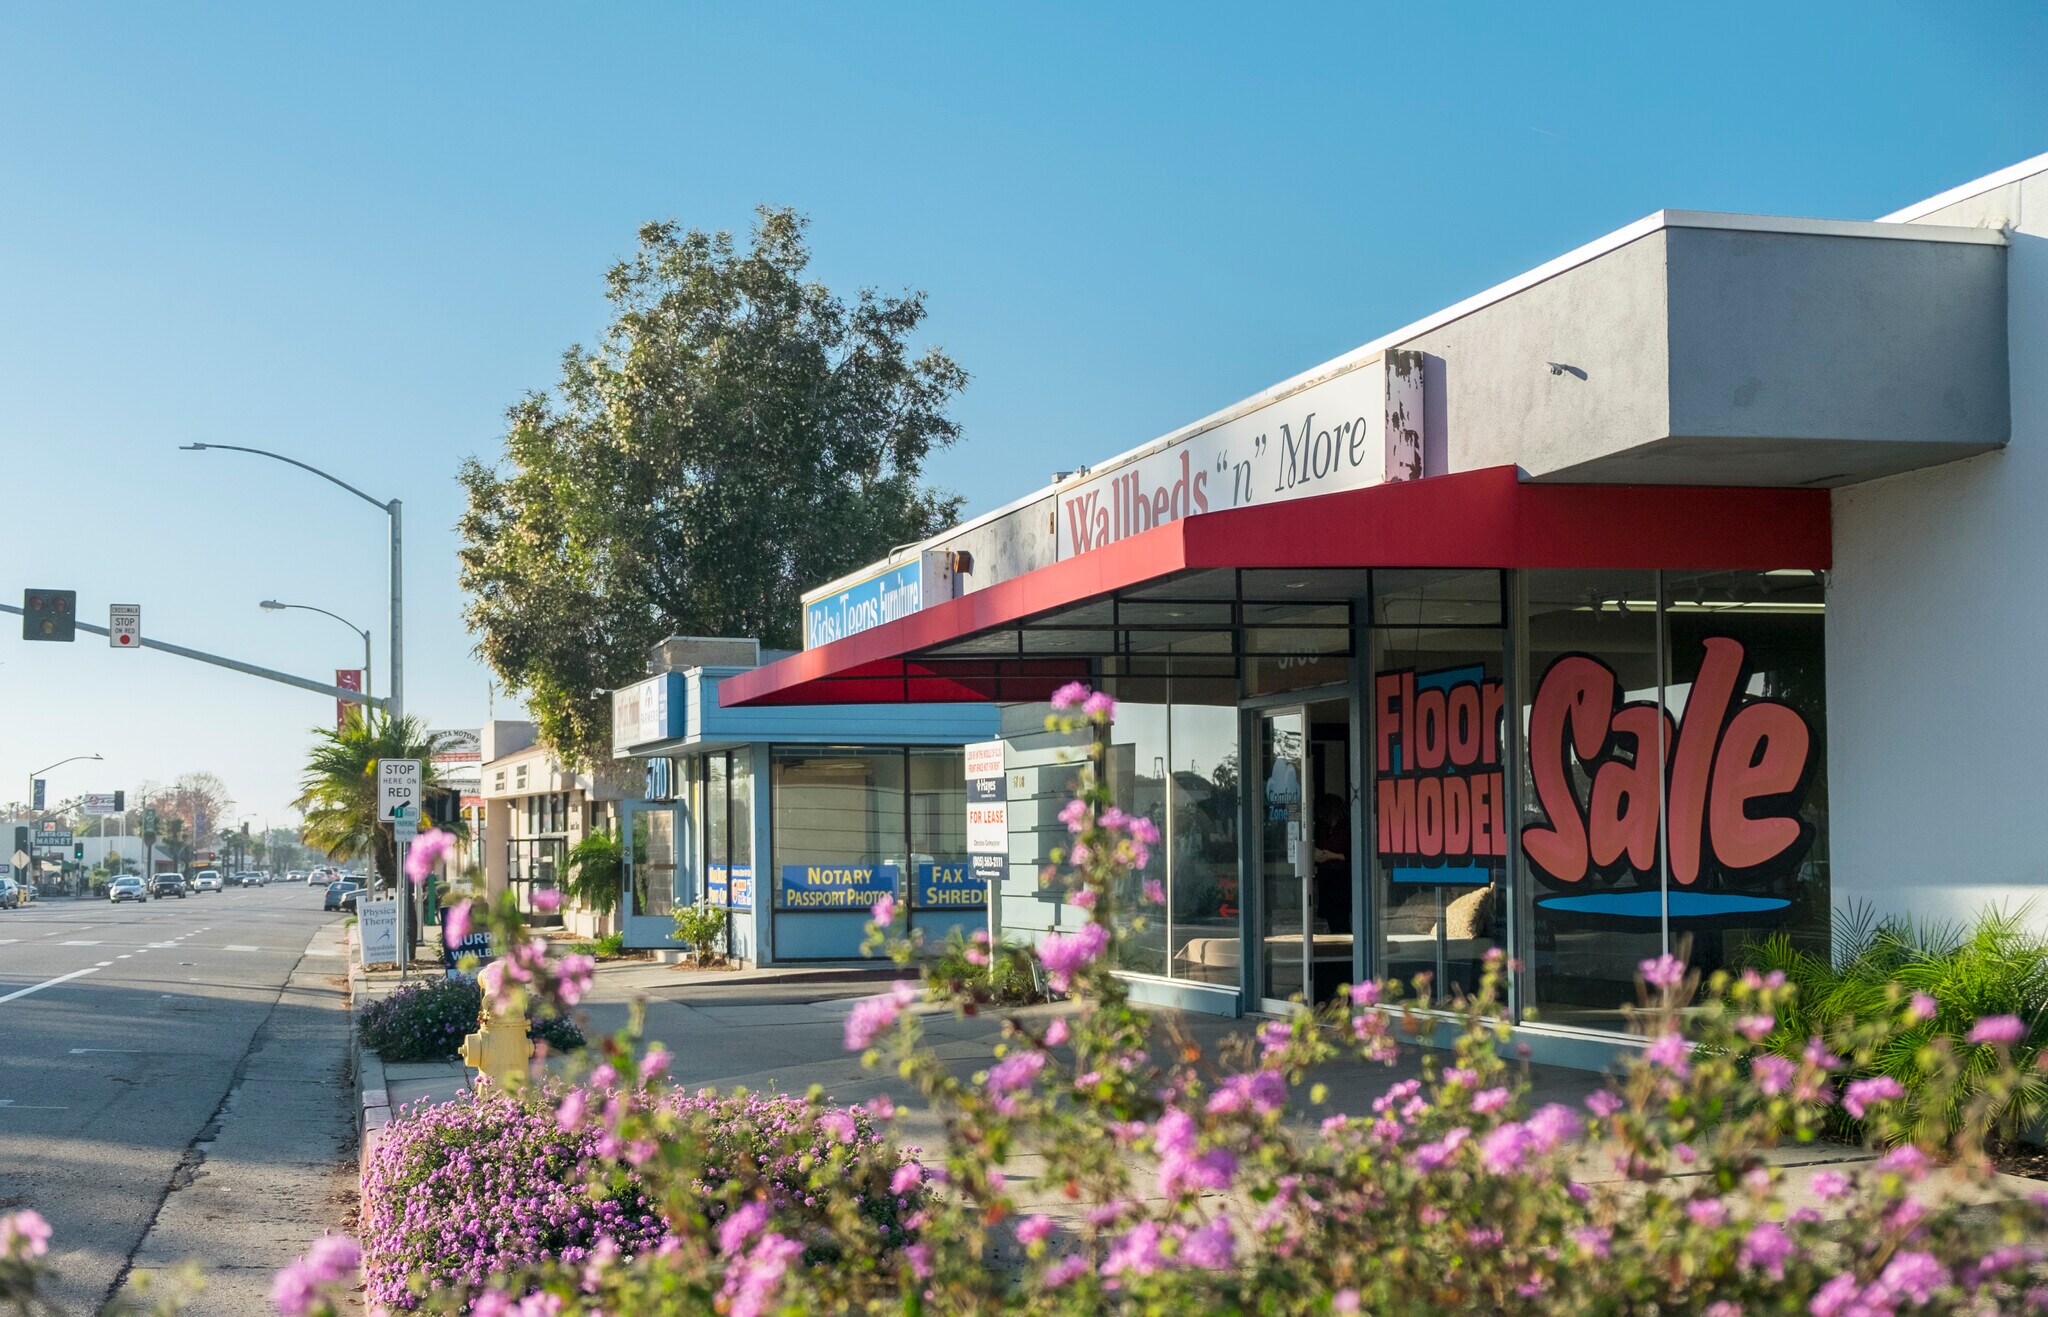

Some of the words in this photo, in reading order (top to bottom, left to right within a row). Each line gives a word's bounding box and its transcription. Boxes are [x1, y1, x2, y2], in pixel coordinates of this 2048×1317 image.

[1065, 449, 1209, 555] Wallbeds
[1274, 412, 1366, 493] More
[810, 606, 835, 650] Kids
[840, 593, 878, 637] Teens
[880, 572, 919, 624] Furniture
[115, 617, 135, 626] STOP
[1376, 671, 1504, 771] Floor
[453, 730, 480, 744] MOTORS
[385, 764, 415, 775] STOP
[1523, 638, 1809, 885] Sale
[388, 788, 411, 797] RED
[1269, 788, 1299, 803] Comfort
[970, 811, 982, 823] FOR
[984, 810, 1003, 823] LEASE
[1269, 805, 1288, 821] Zone
[1377, 772, 1507, 857] MODEL
[807, 867, 873, 885] NOTARY
[932, 866, 963, 883] FAX
[787, 888, 845, 906] PASSPORT
[847, 888, 893, 906] PHOTOS
[363, 908, 396, 917] Physica
[363, 917, 397, 926] Therap
